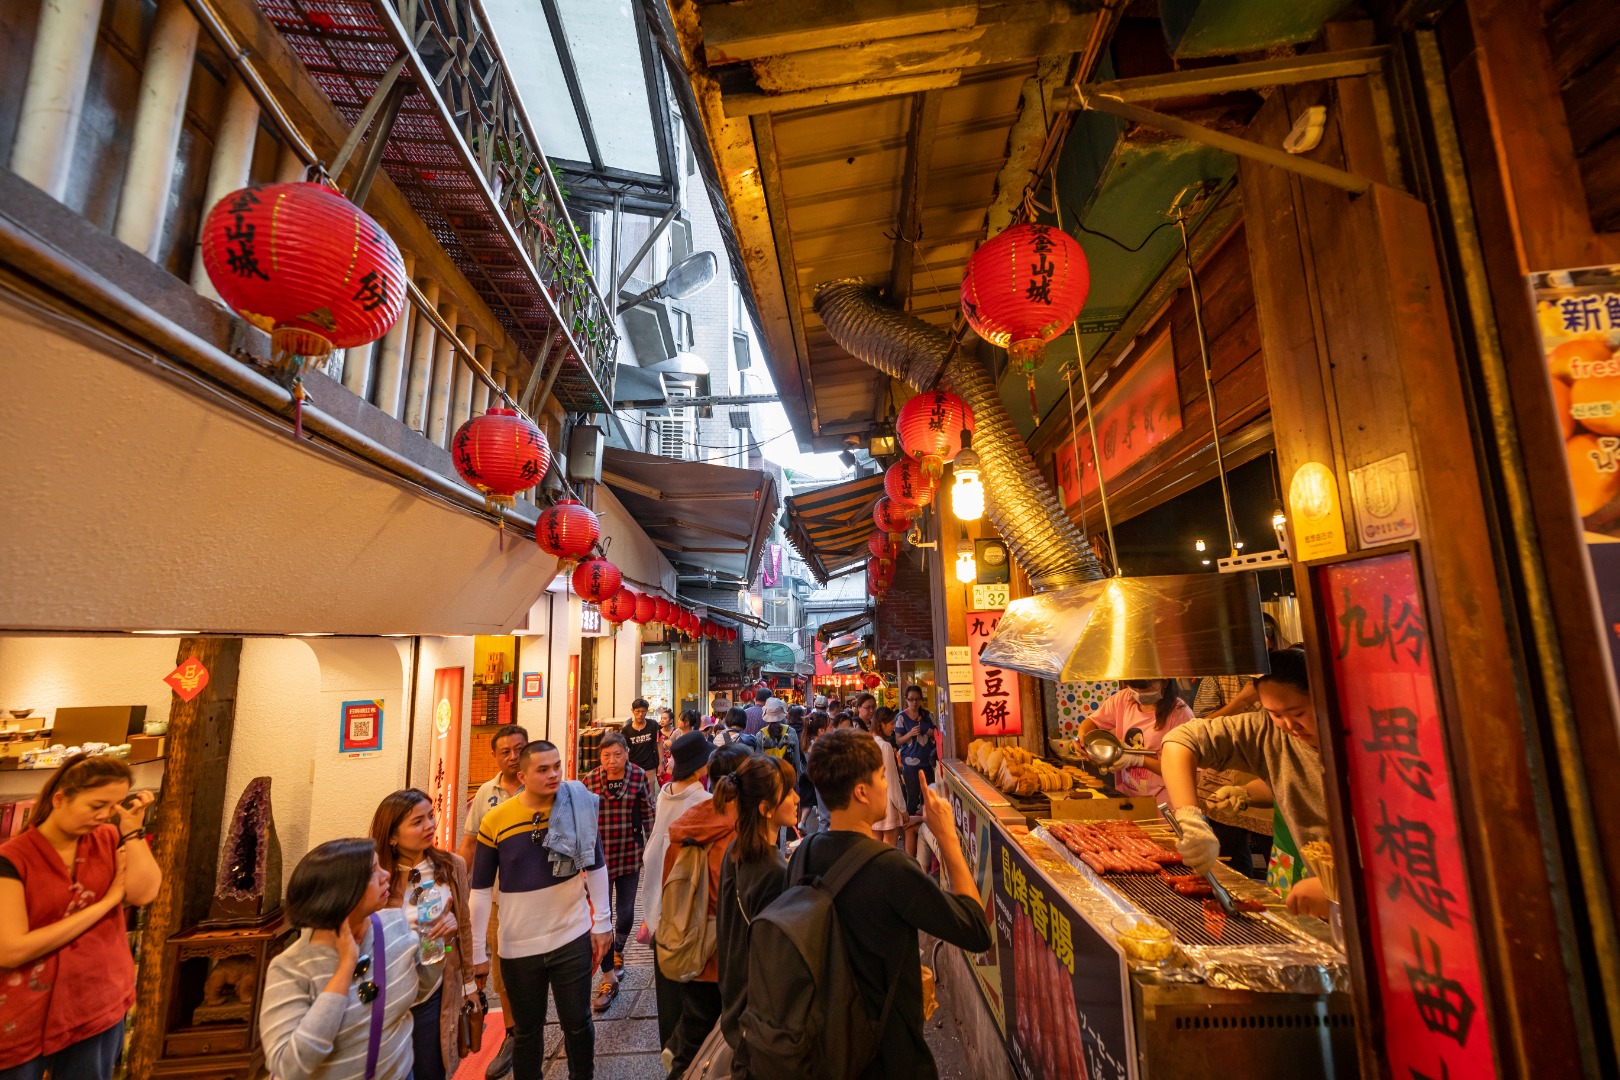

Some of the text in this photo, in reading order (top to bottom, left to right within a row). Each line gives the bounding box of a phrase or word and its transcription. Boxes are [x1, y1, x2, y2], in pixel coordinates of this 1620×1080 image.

[1571, 357, 1620, 378] fres
[988, 593, 1005, 606] 32
[1337, 586, 1429, 667] 九份
[1363, 706, 1477, 1080] 思想曲
